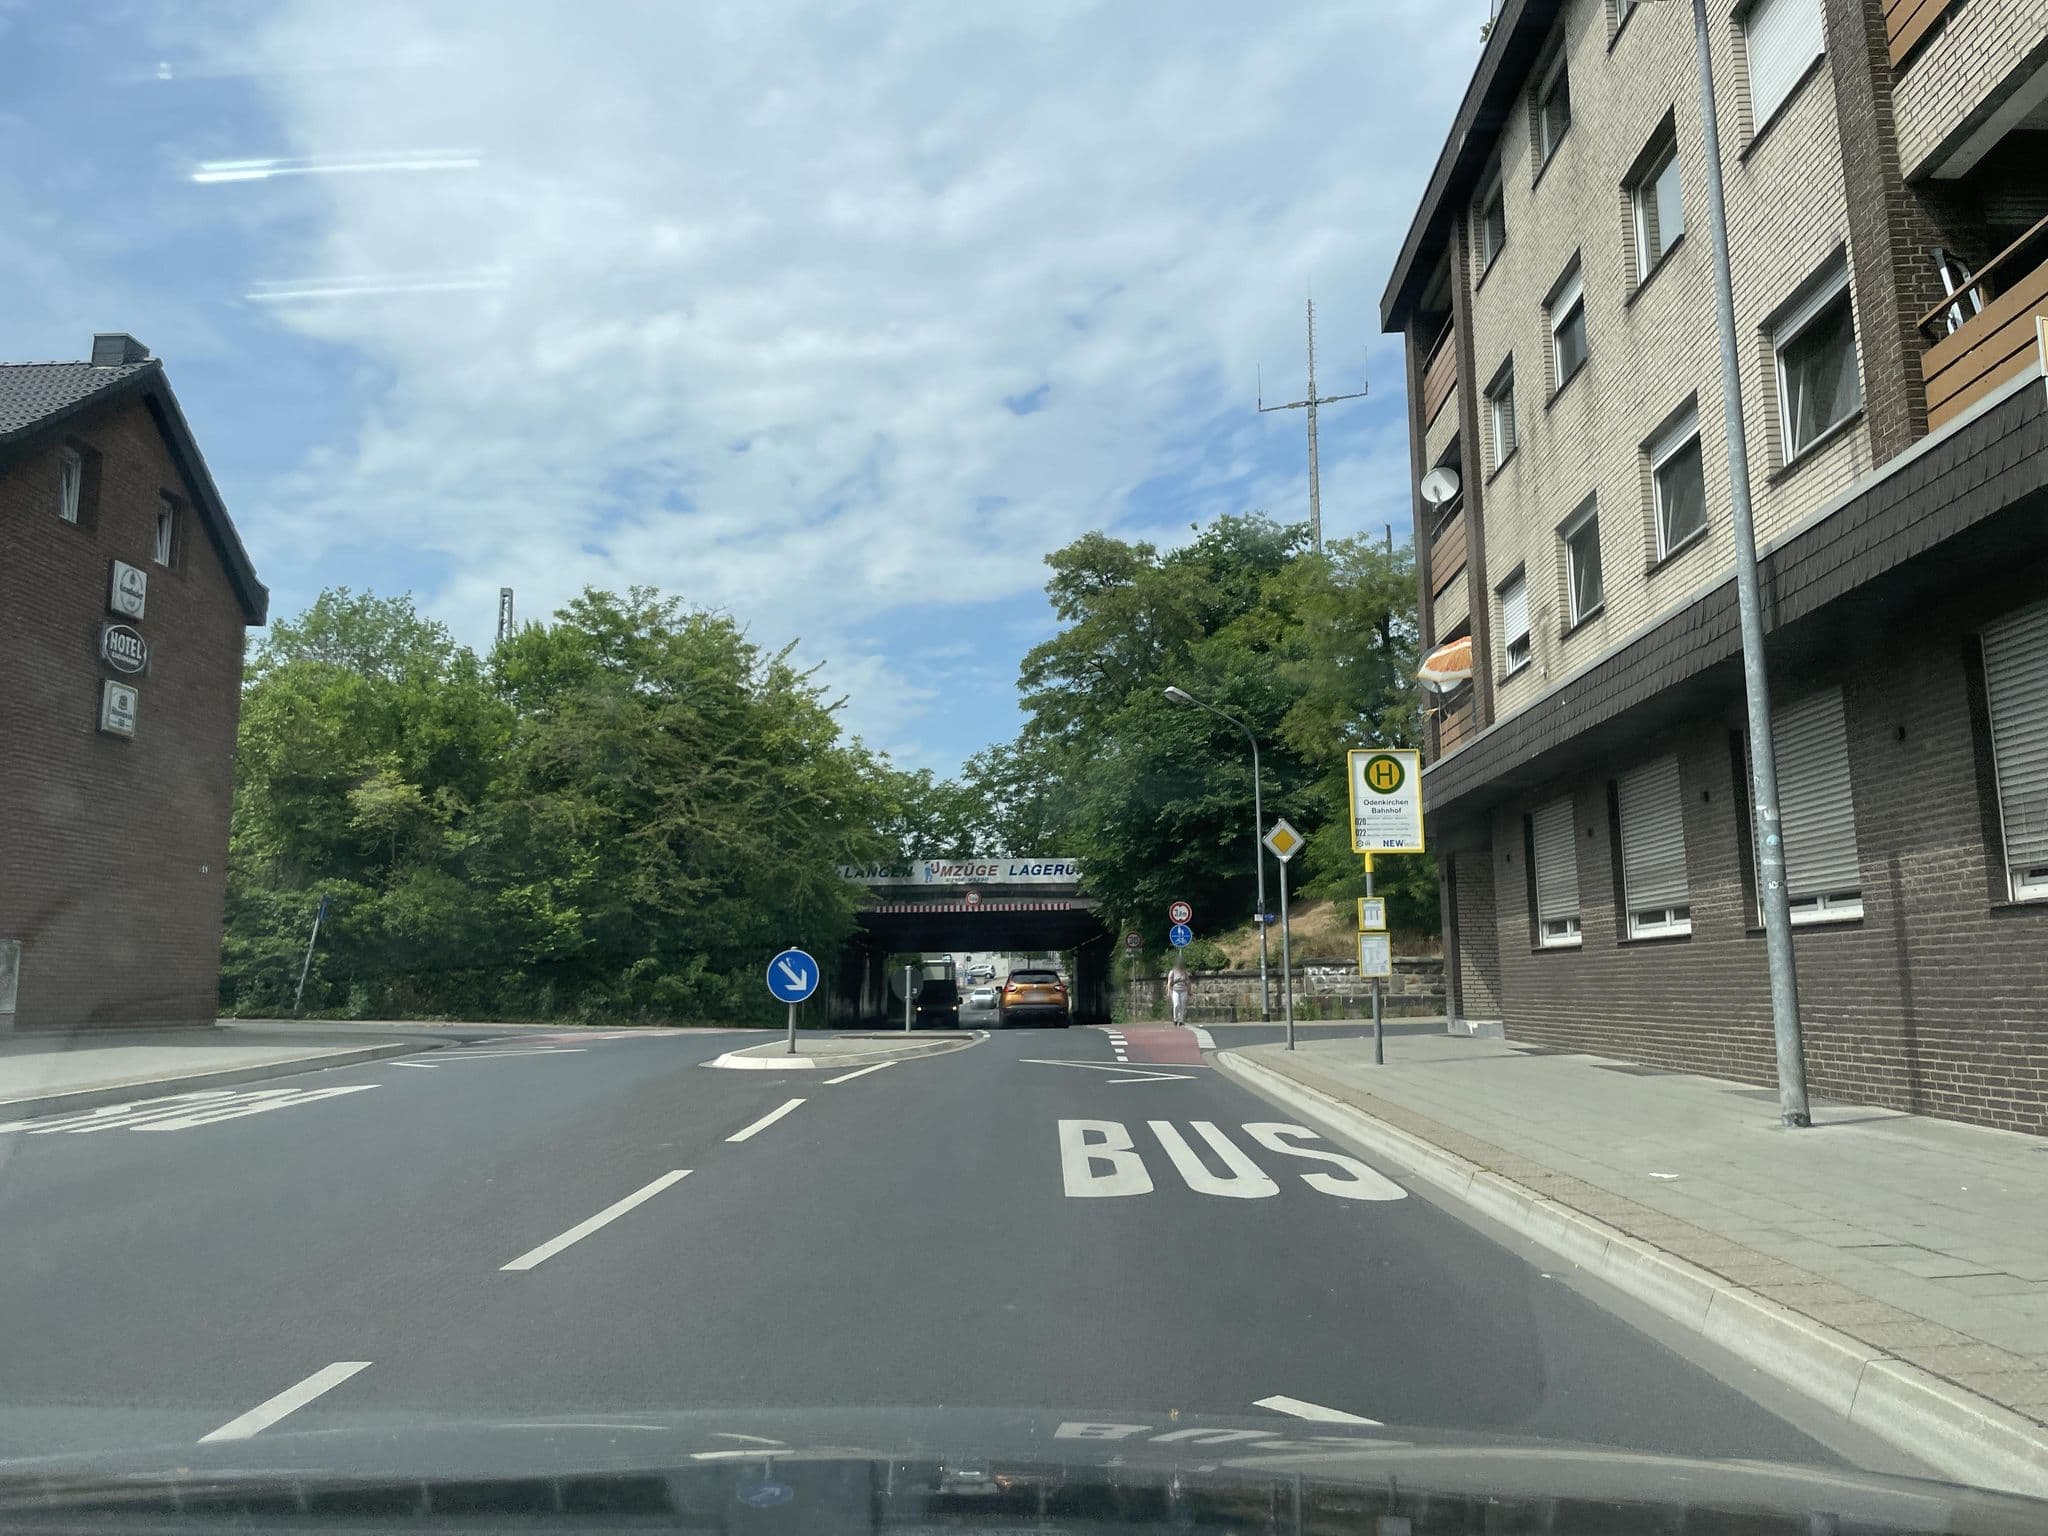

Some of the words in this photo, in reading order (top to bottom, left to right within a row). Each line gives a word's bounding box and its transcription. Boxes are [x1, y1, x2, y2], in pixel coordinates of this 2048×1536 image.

[110, 631, 142, 659] HOTEL
[1376, 764, 1393, 785] H
[931, 861, 998, 877] UMZÜGE
[1009, 864, 1081, 876] LAGERU
[1058, 1119, 1409, 1201] BUS
